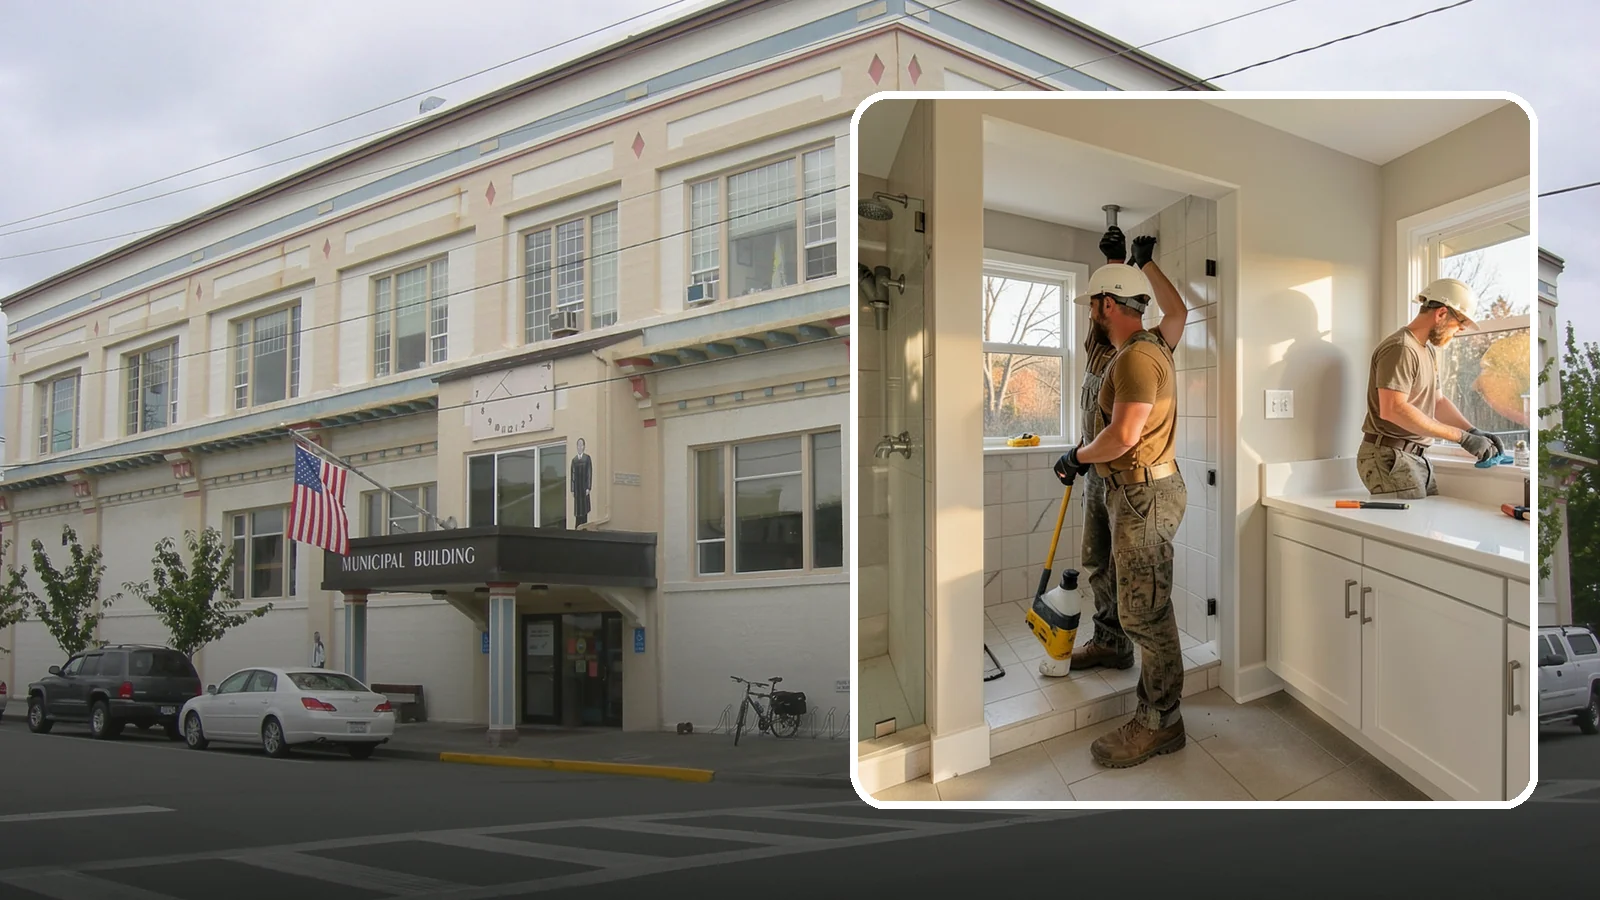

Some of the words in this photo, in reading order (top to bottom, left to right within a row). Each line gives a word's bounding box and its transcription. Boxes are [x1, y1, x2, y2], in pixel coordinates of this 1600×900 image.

[480, 407, 485, 415] 8
[488, 418, 492, 426] 9
[494, 424, 500, 432] 10
[507, 425, 513, 433] 12
[521, 420, 525, 428] 2
[536, 402, 540, 410] 4
[341, 553, 405, 572] MUNICIPAL
[414, 546, 476, 567] BUILDING
